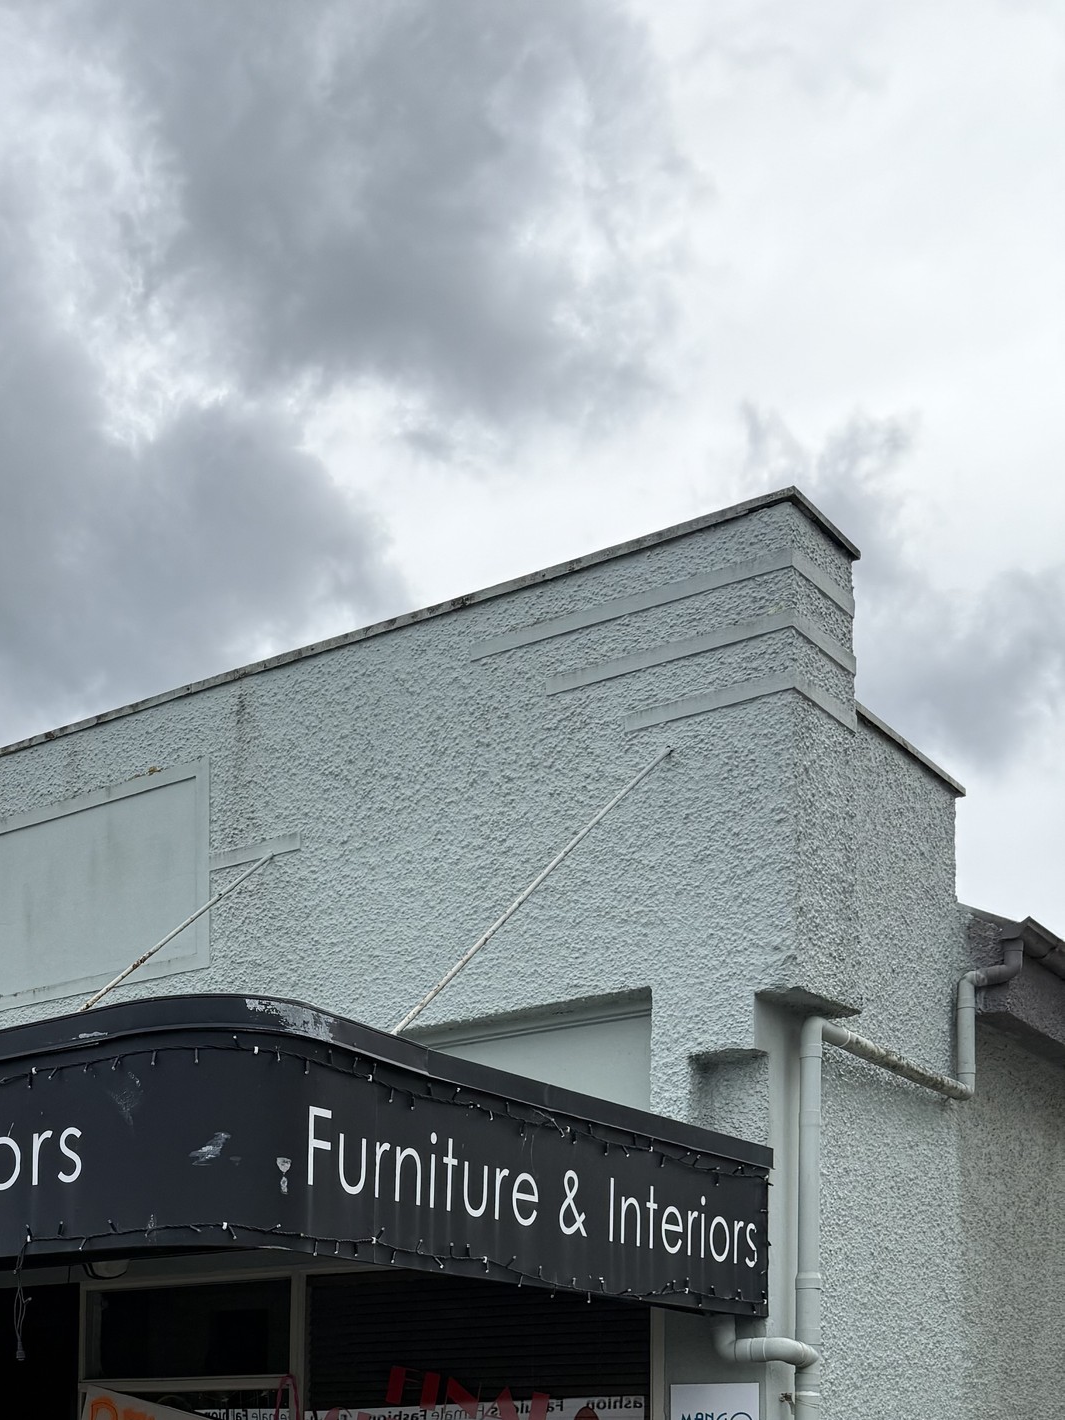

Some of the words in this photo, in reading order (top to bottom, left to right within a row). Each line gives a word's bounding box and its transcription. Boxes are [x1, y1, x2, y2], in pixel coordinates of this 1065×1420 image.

[307, 1105, 540, 1228] Furniture
[558, 1168, 588, 1239] &
[608, 1175, 759, 1269] Interiors
